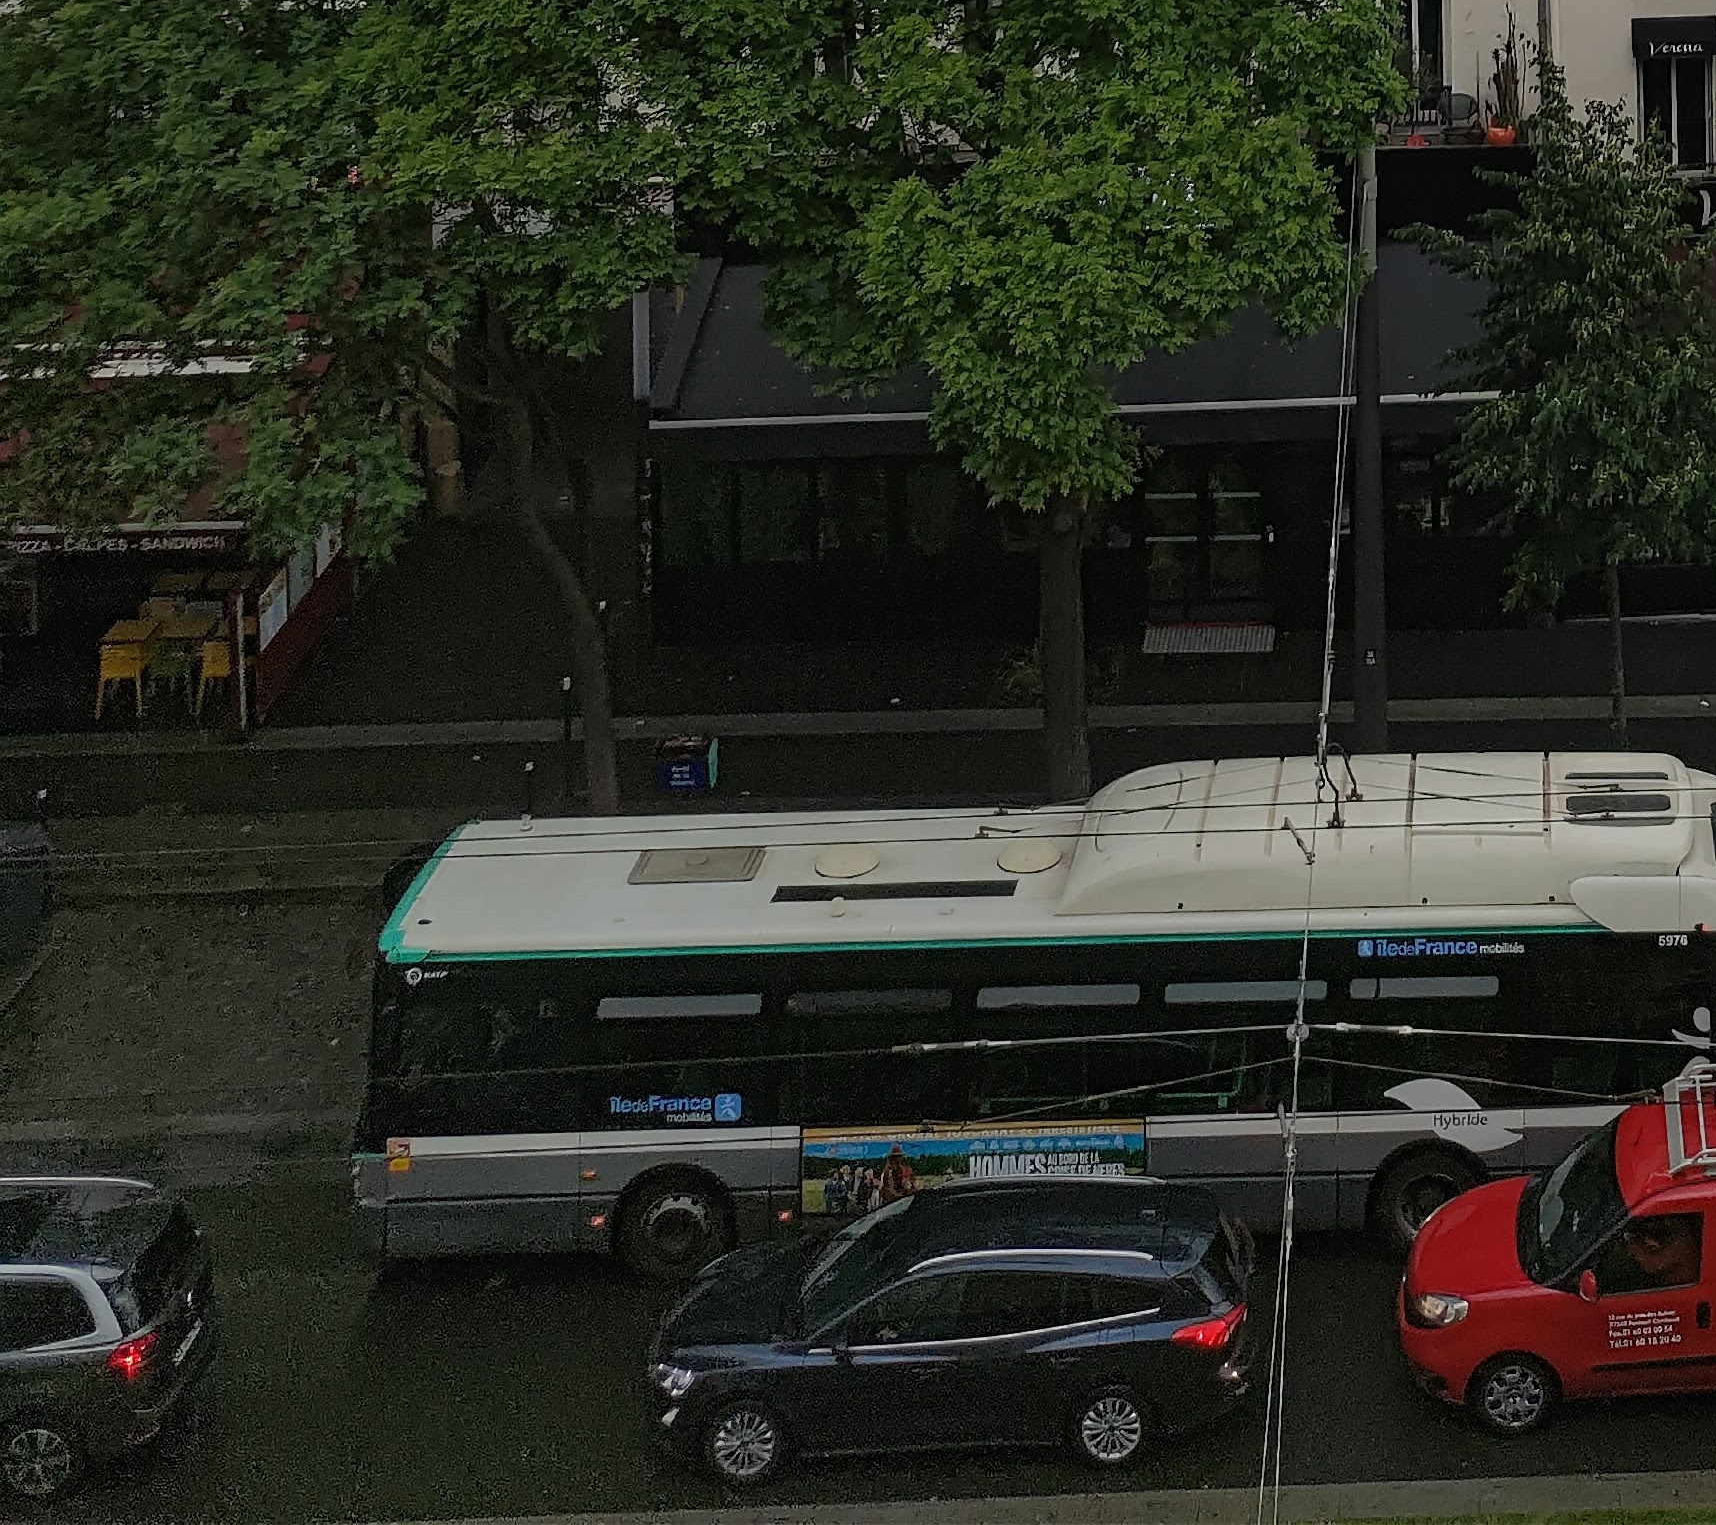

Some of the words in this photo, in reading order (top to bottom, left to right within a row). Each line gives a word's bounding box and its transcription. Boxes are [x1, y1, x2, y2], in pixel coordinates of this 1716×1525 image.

[1649, 41, 1704, 57] Verona
[1433, 1113, 1489, 1130] Hybride
[969, 1153, 1047, 1178] HOMMES
